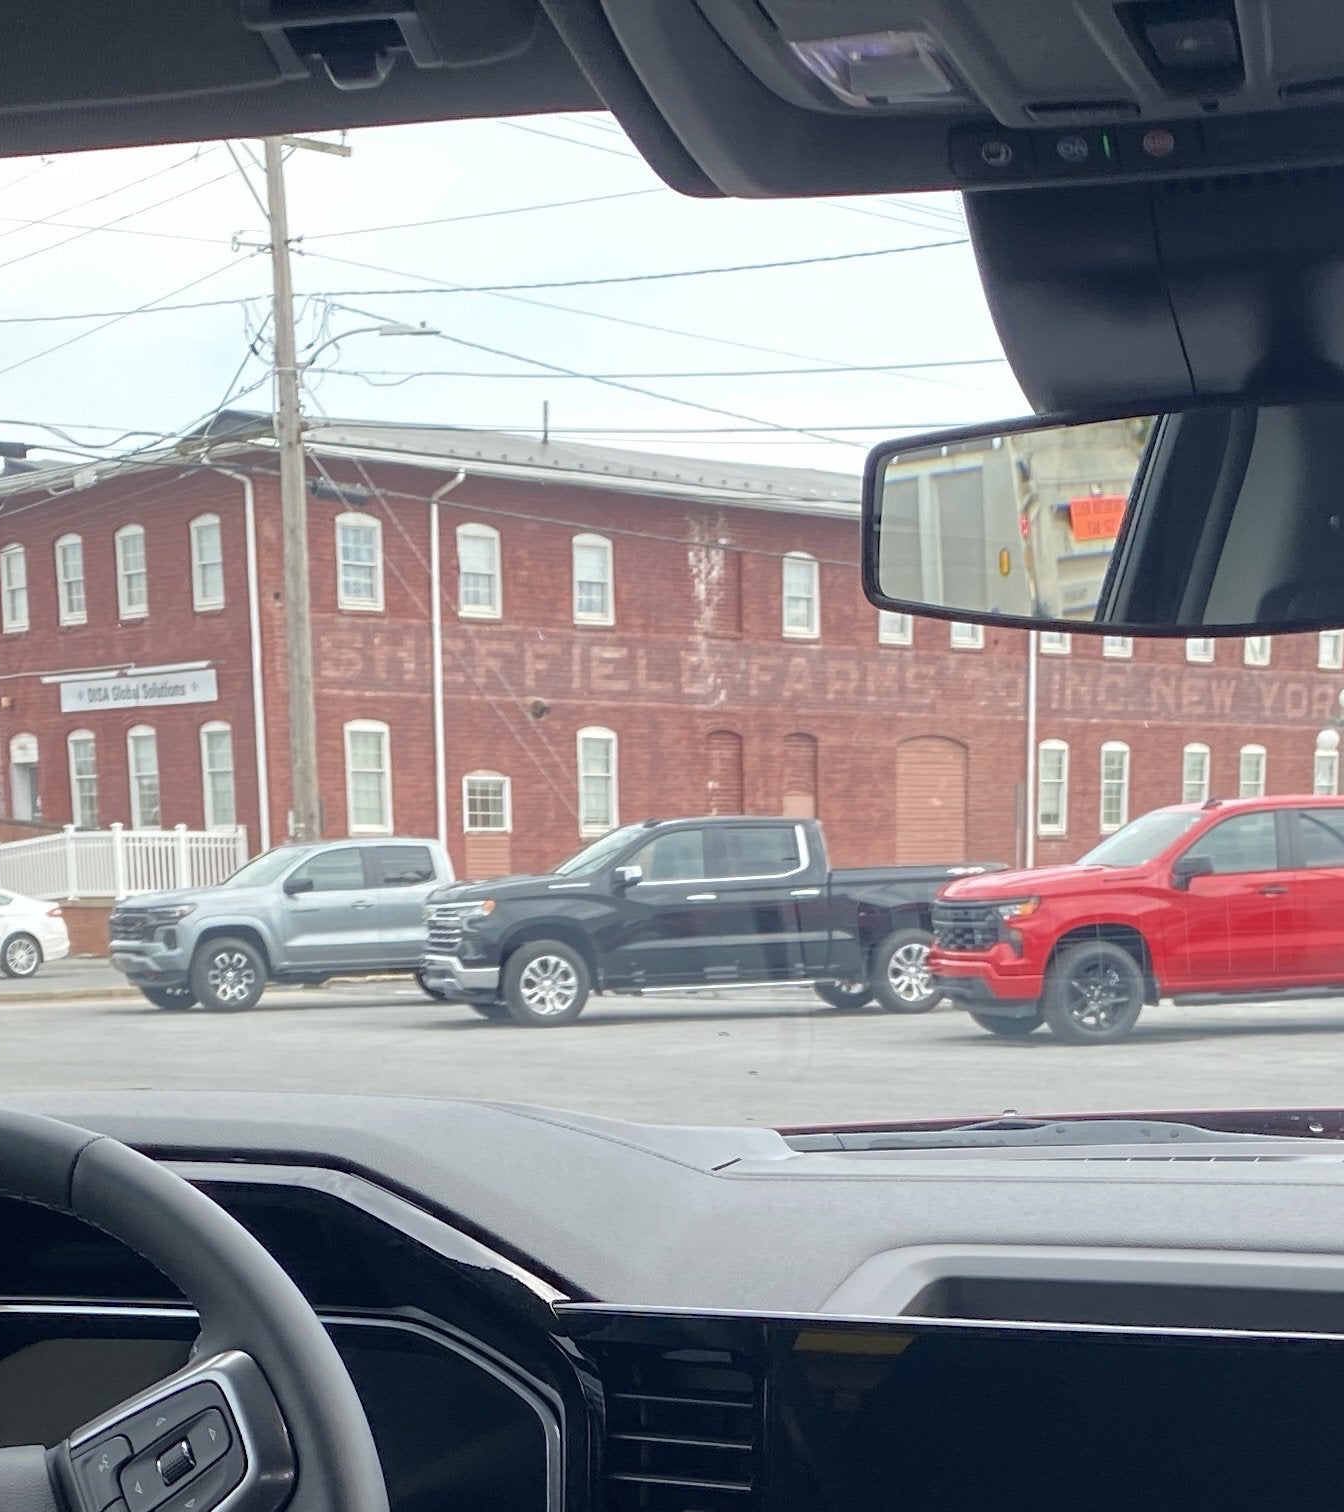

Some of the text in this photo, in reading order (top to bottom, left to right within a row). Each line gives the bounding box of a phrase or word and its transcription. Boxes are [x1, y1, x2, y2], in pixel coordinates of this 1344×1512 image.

[111, 683, 140, 701] Global
[142, 681, 187, 699] Solutions
[1150, 677, 1237, 717] NEW
[1259, 682, 1342, 720] YOR
